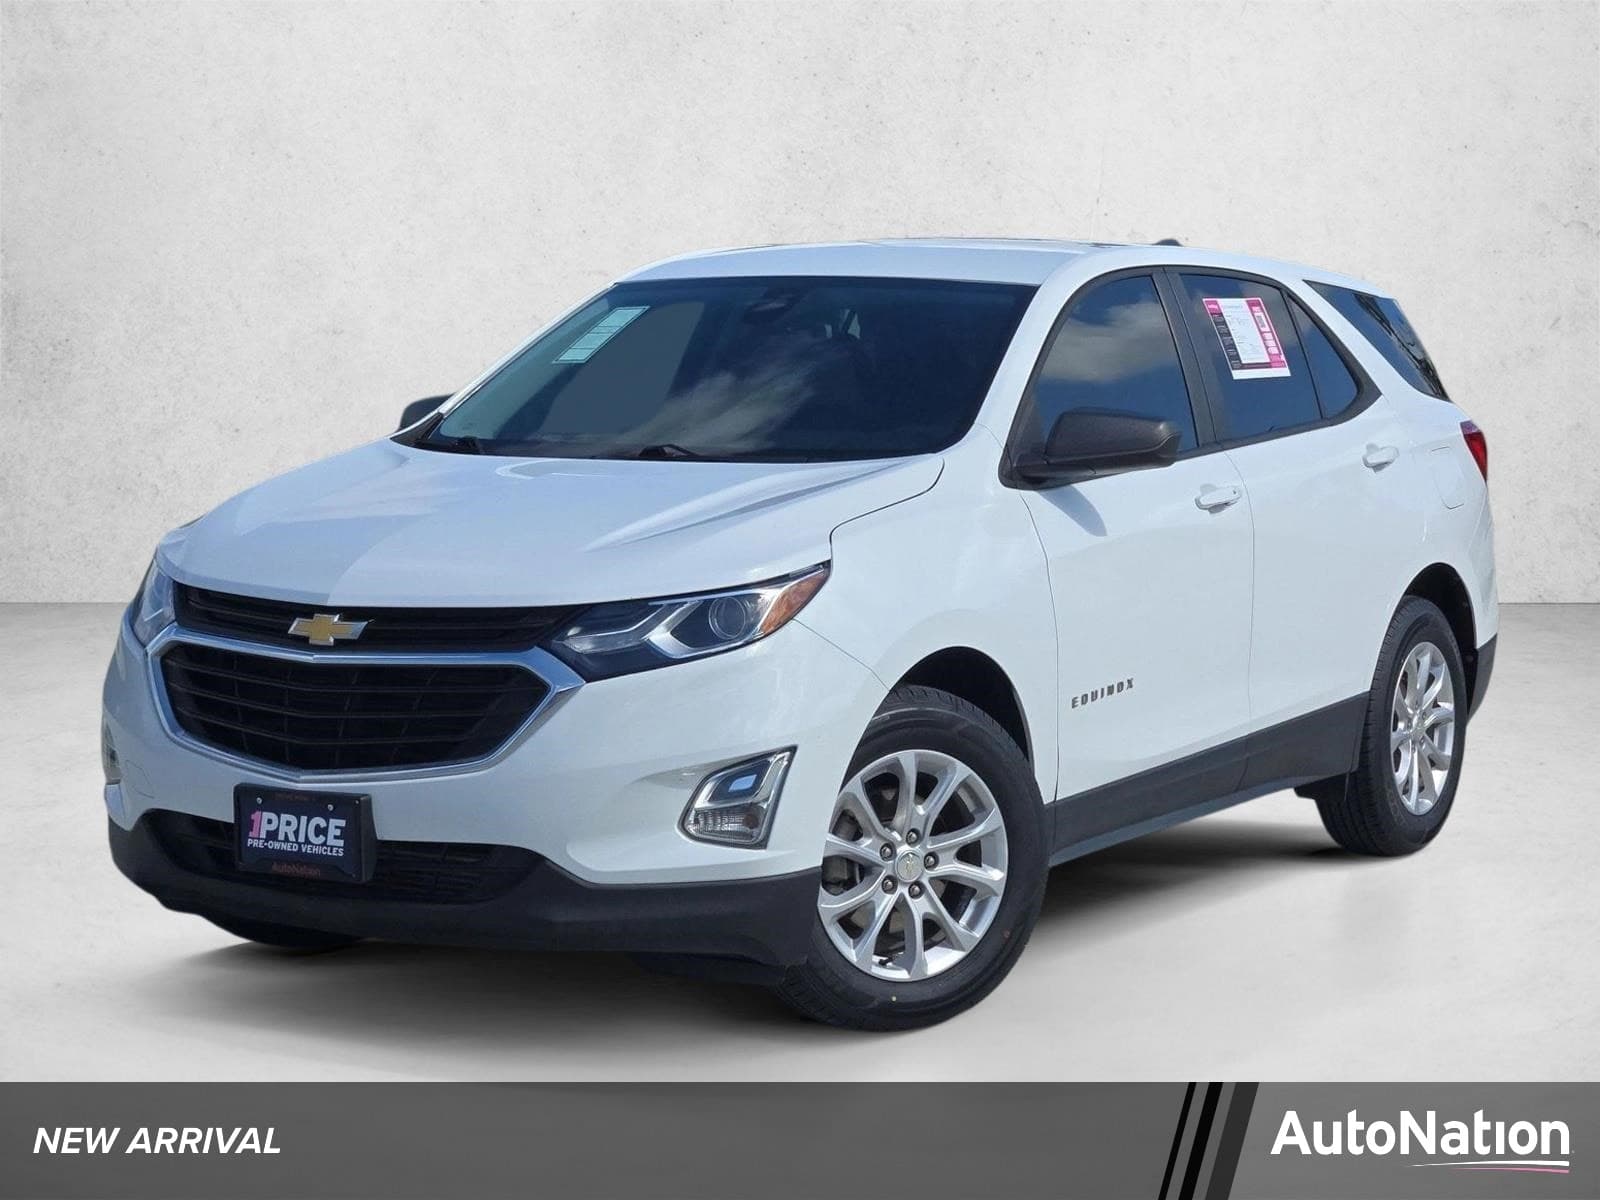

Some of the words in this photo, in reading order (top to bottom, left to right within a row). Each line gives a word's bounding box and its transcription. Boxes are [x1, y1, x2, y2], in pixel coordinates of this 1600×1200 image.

[1071, 678, 1134, 709] EQUINOX
[247, 838, 299, 852] PRE-OWNED
[301, 844, 345, 857] VEHICLES
[271, 861, 321, 878] AutoNation
